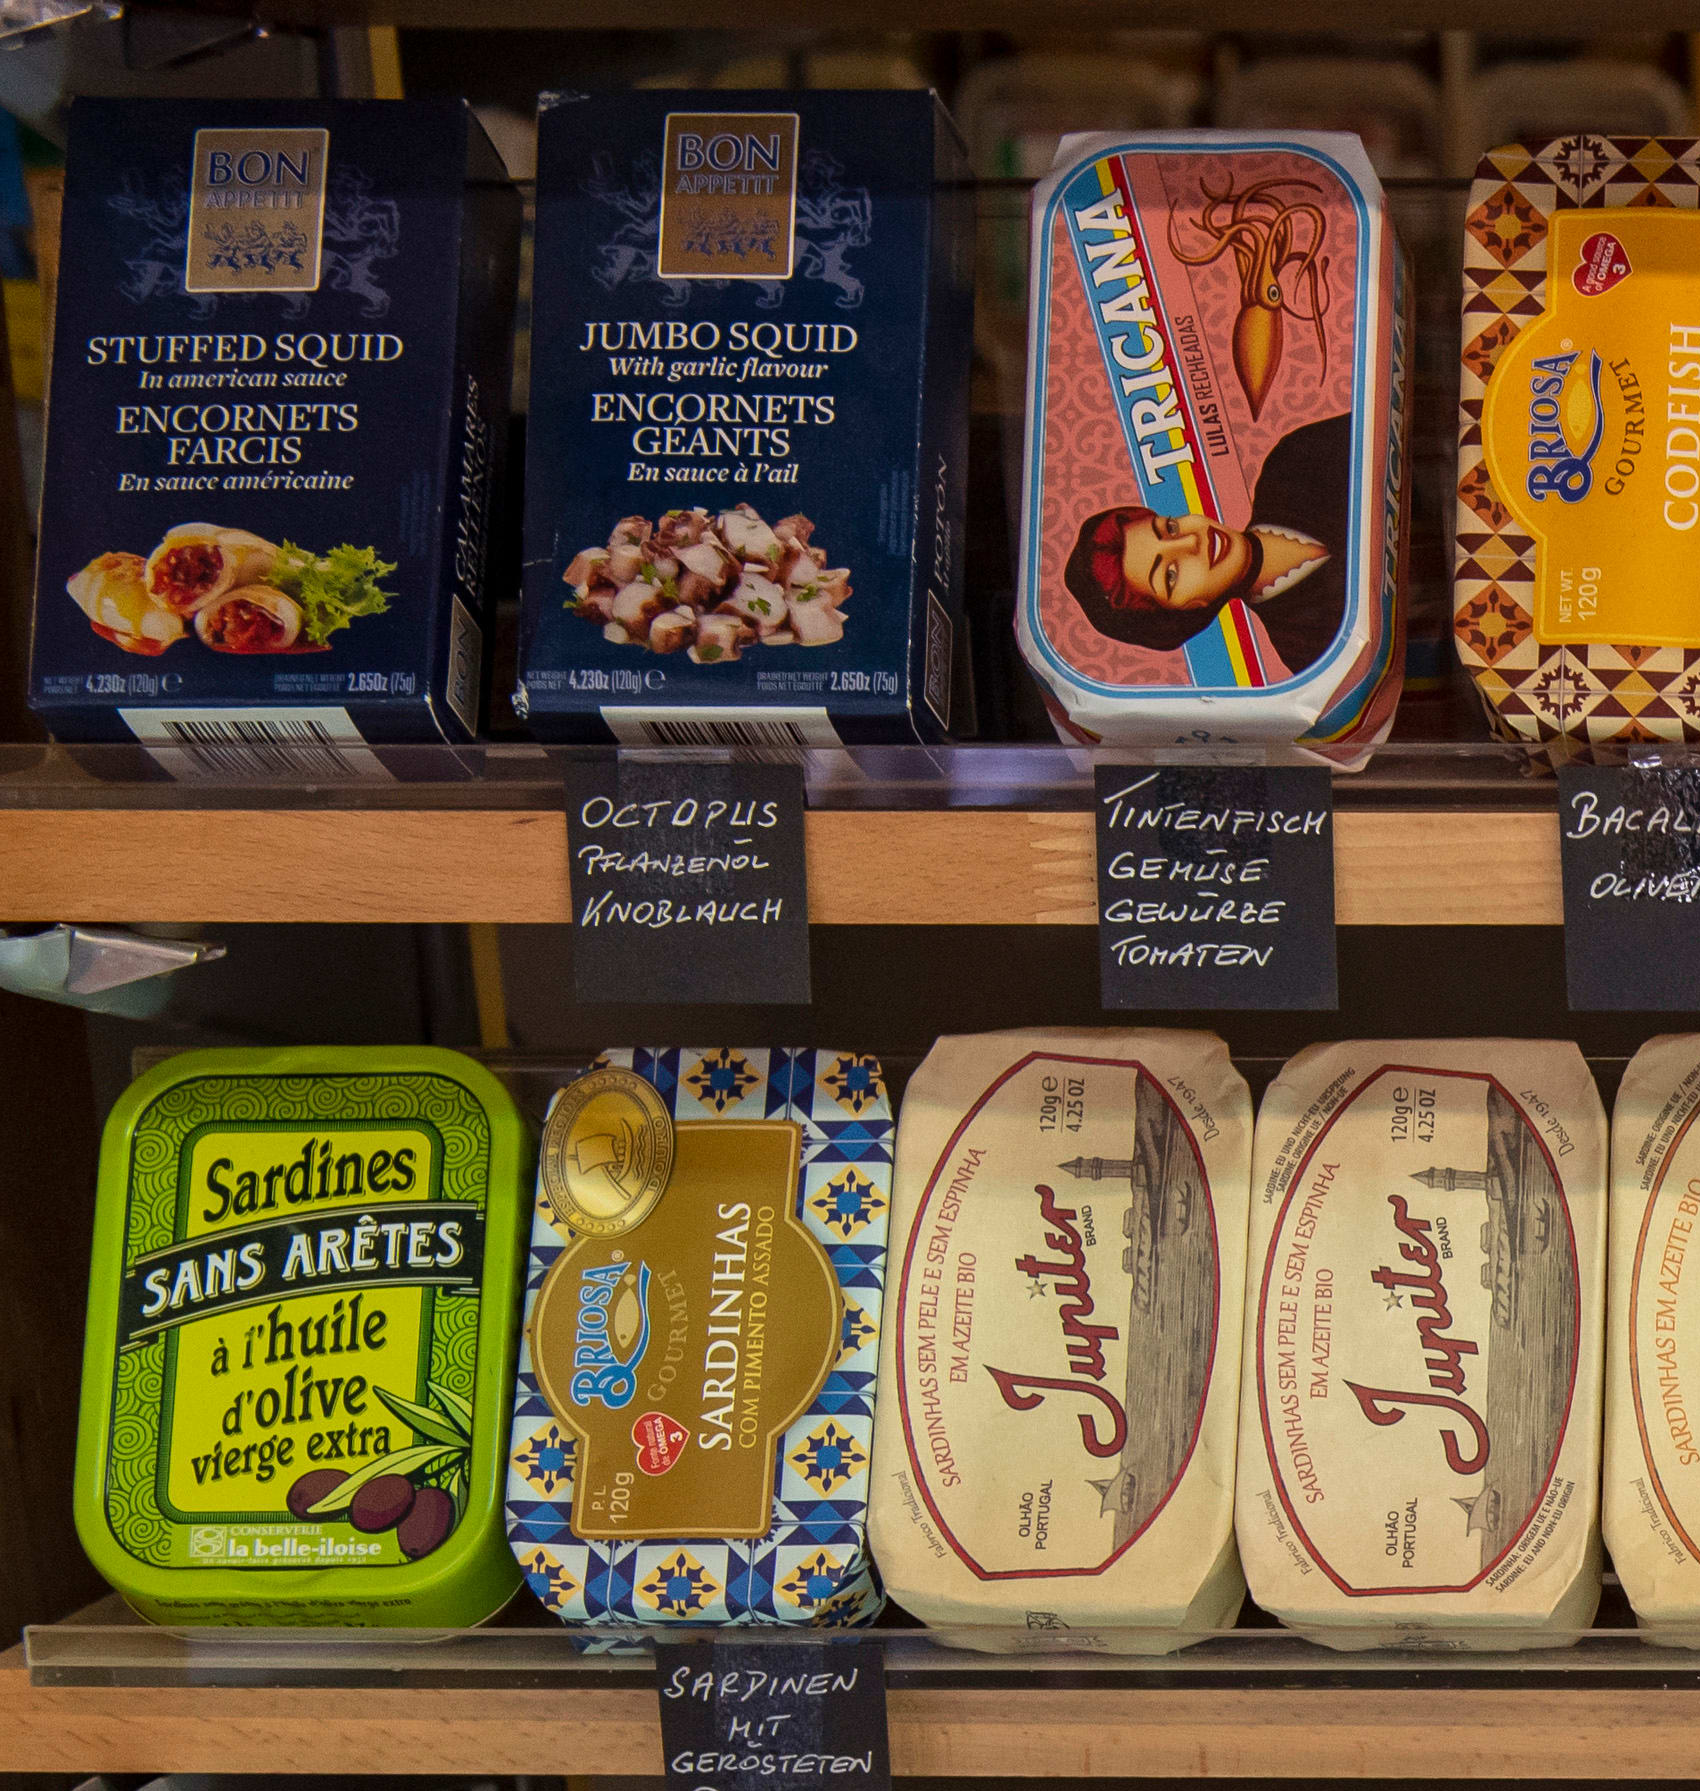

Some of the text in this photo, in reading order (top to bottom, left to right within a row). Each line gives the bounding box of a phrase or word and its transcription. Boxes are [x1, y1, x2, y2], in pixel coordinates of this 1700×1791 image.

[207, 150, 309, 187] BON
[86, 333, 403, 365] STUFFED SQUID
[580, 322, 858, 357] JUMBO SQUID
[1075, 187, 1194, 486] TRICANA
[138, 371, 348, 388] In american sauce
[609, 357, 827, 382] With garlic flavour
[116, 404, 359, 435] ENCORNETS
[591, 394, 835, 426] ENCORNETS
[1200, 397, 1229, 458] LULAS
[1526, 348, 1597, 504] BRIOSA
[1605, 357, 1646, 496] GOURMET
[167, 437, 302, 465] FARCIS
[631, 421, 790, 458] GÉANTS
[1577, 566, 1602, 621] 120g
[580, 797, 779, 828] OCTOPUS
[1103, 773, 1327, 835] TINTENFISCH
[580, 891, 782, 928] KNOBLAUCH
[1111, 942, 1273, 969] TOMATEN
[203, 1138, 417, 1224] Sardines
[142, 1213, 466, 1316] SANS ARÊTES
[211, 1294, 388, 1377] à l'huile
[570, 1260, 637, 1410] BRIOSA
[699, 1201, 753, 1451] SARDINHAS
[984, 1184, 1127, 1459] Jupiter
[1344, 1194, 1491, 1476] Jupiter
[222, 1367, 367, 1439] d'olive
[192, 1424, 391, 1486] vierge extra
[230, 1525, 322, 1537] CONSERVERIE
[1018, 1492, 1034, 1540] OLHÃO
[1034, 1479, 1053, 1551] PORTUGAL
[226, 1538, 381, 1558] la belle-iloise
[664, 1666, 858, 1701] SARDINEN
[729, 1714, 791, 1742] MIT
